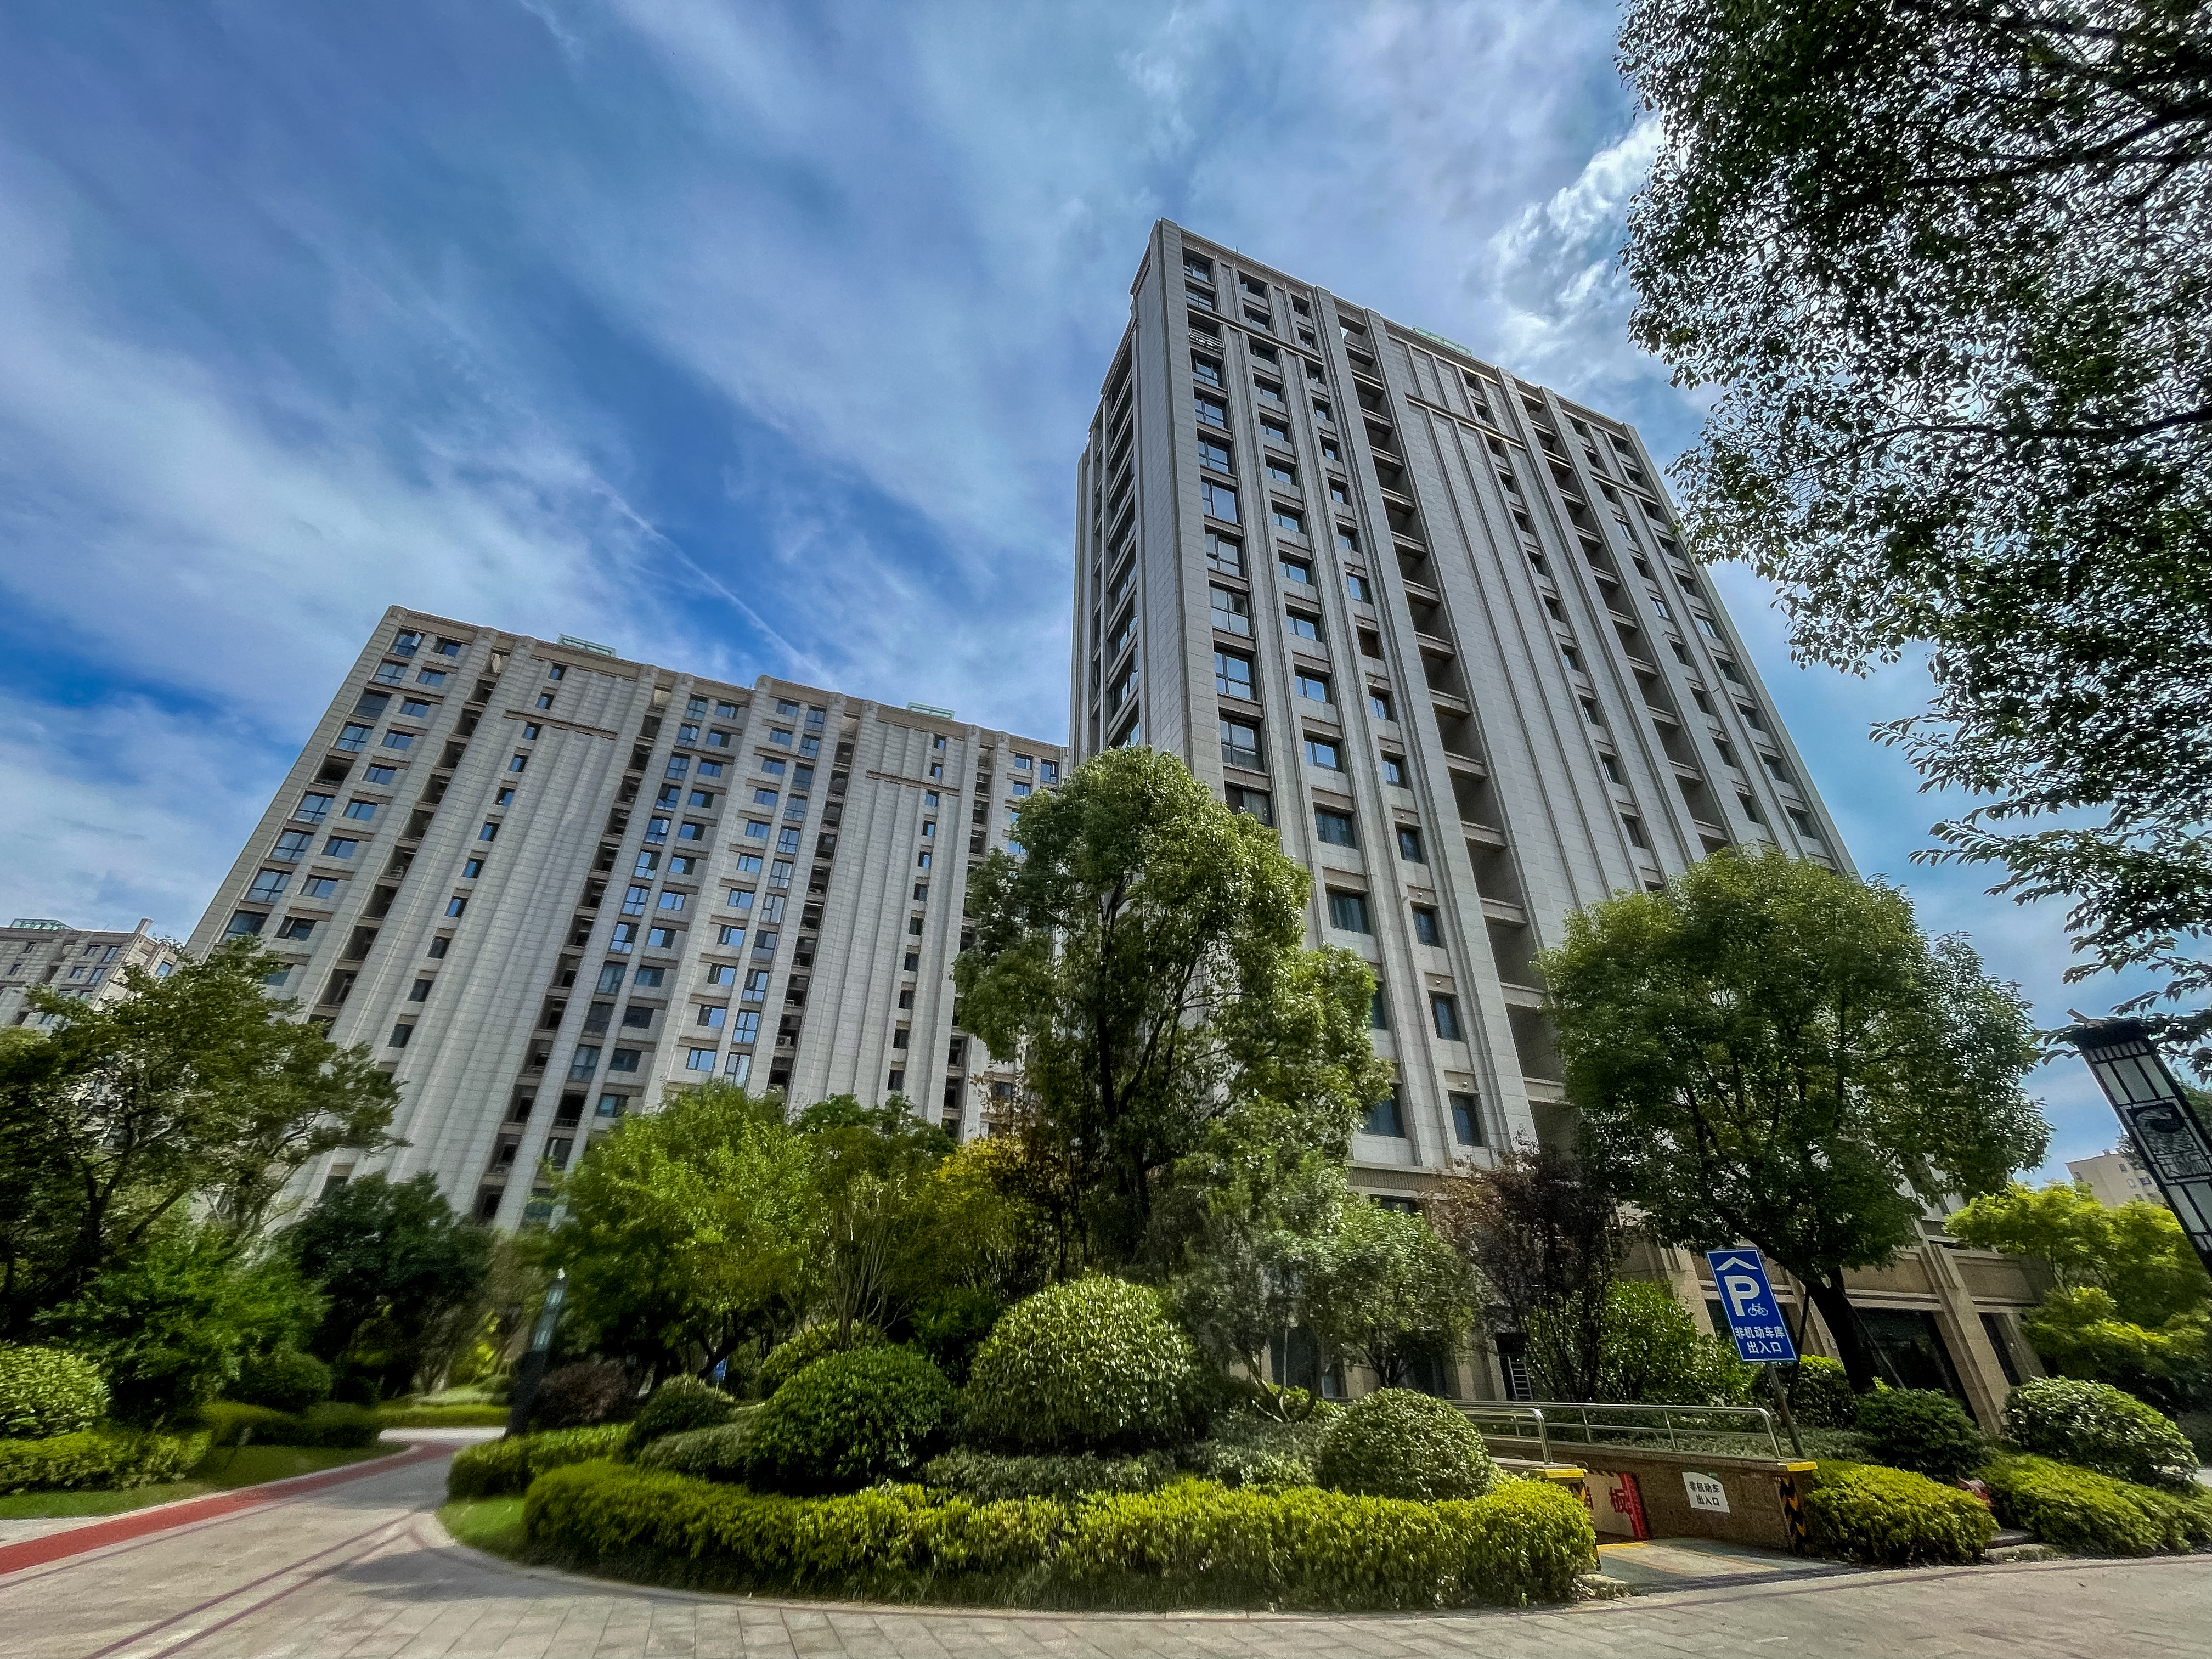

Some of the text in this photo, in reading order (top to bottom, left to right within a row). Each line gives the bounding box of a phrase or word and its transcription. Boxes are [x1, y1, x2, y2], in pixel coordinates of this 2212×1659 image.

[1724, 1275, 1760, 1317] P
[1734, 1326, 1785, 1339] 非机动车库
[1747, 1341, 1783, 1354] 出入口
[1689, 1480, 1720, 1494] 非机动车
[1696, 1493, 1720, 1507] 出入口
